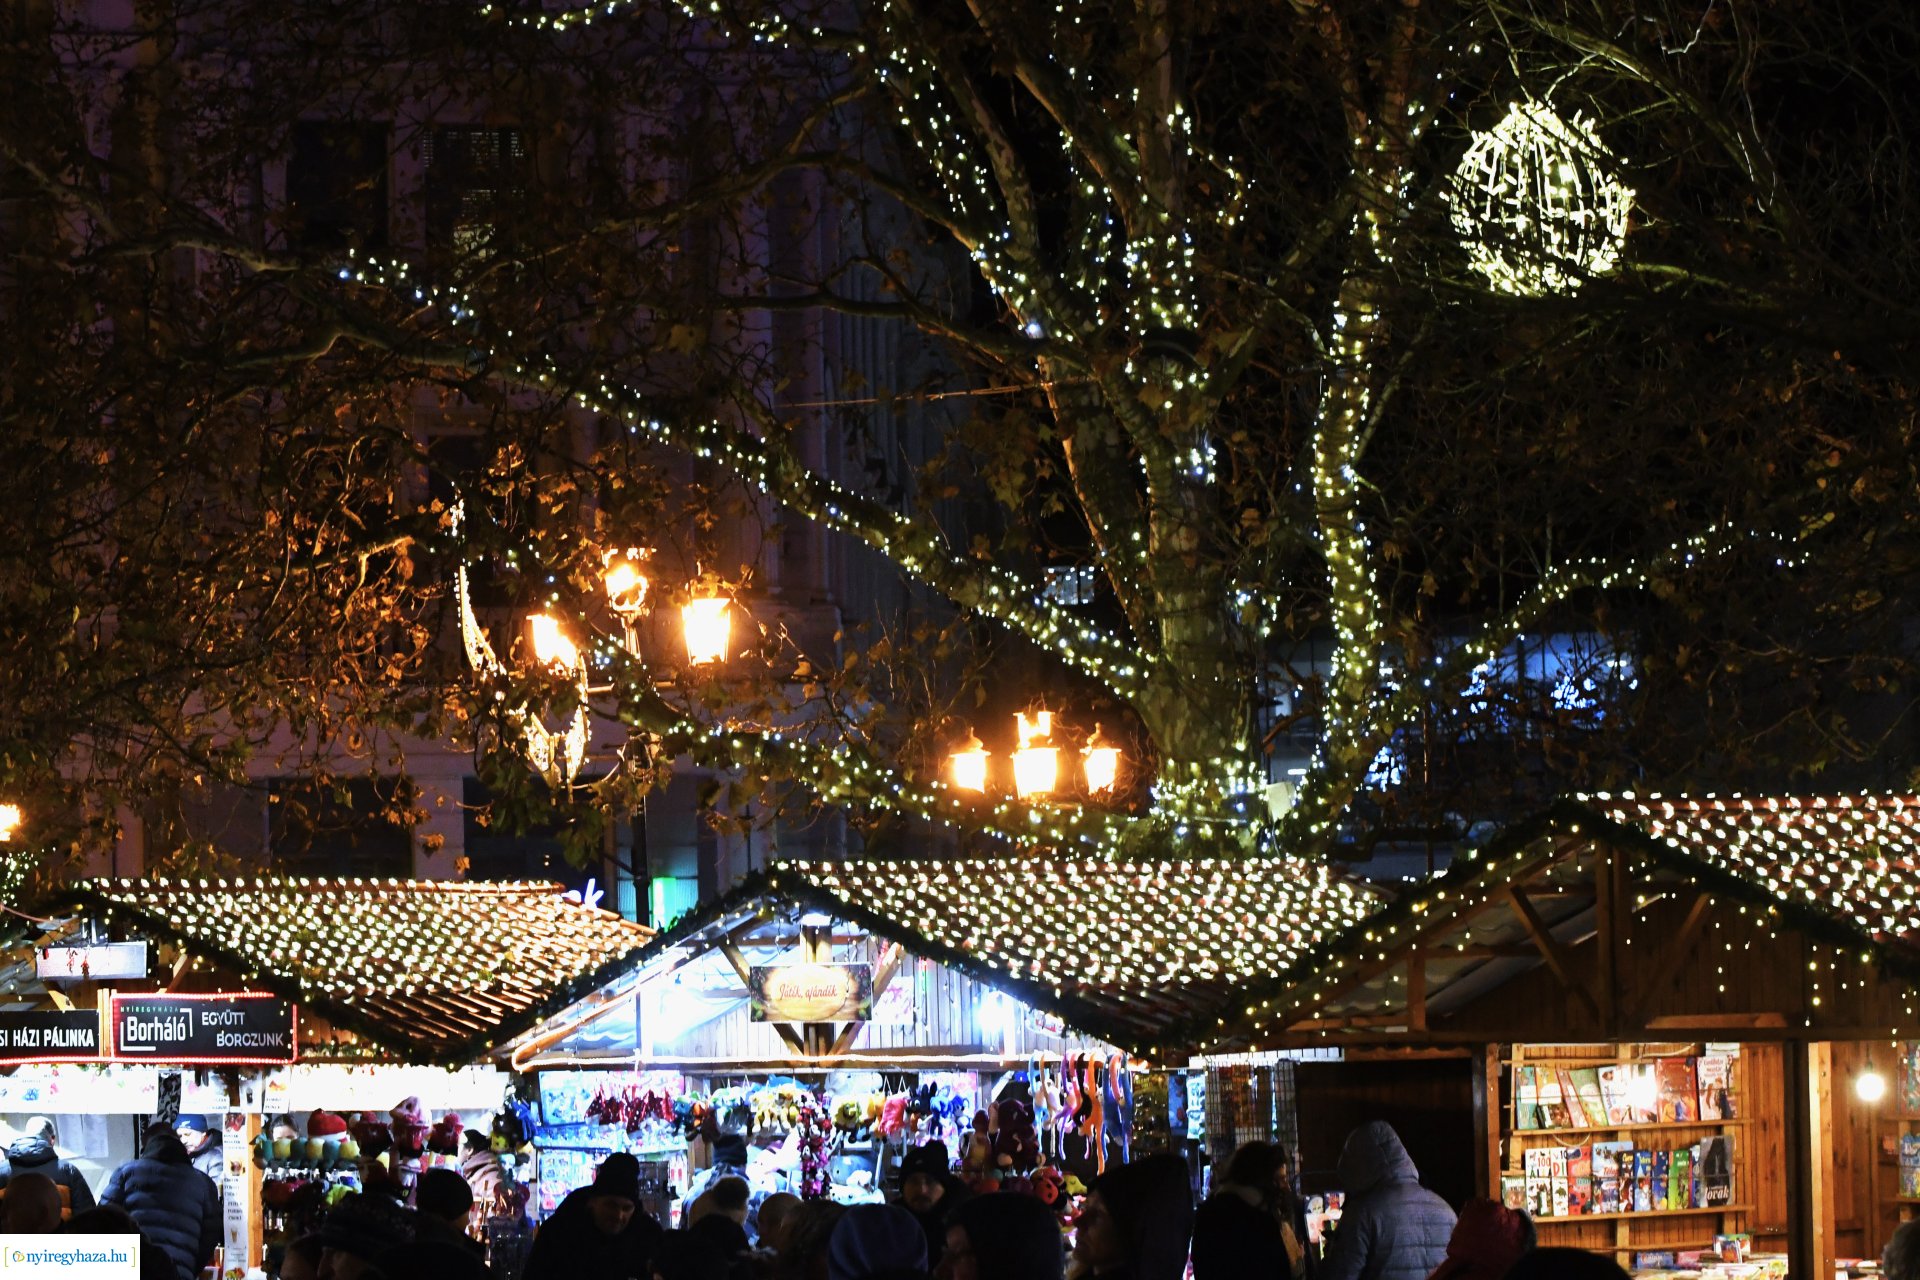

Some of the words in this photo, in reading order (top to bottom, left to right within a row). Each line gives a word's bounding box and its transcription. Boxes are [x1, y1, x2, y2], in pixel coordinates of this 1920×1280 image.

[201, 1009, 245, 1026] EGYÜTT
[13, 1026, 40, 1047] HÁZI
[43, 1026, 95, 1047] PÁLINKA
[126, 1016, 186, 1042] Borháló
[216, 1032, 284, 1047] BOROZUNK
